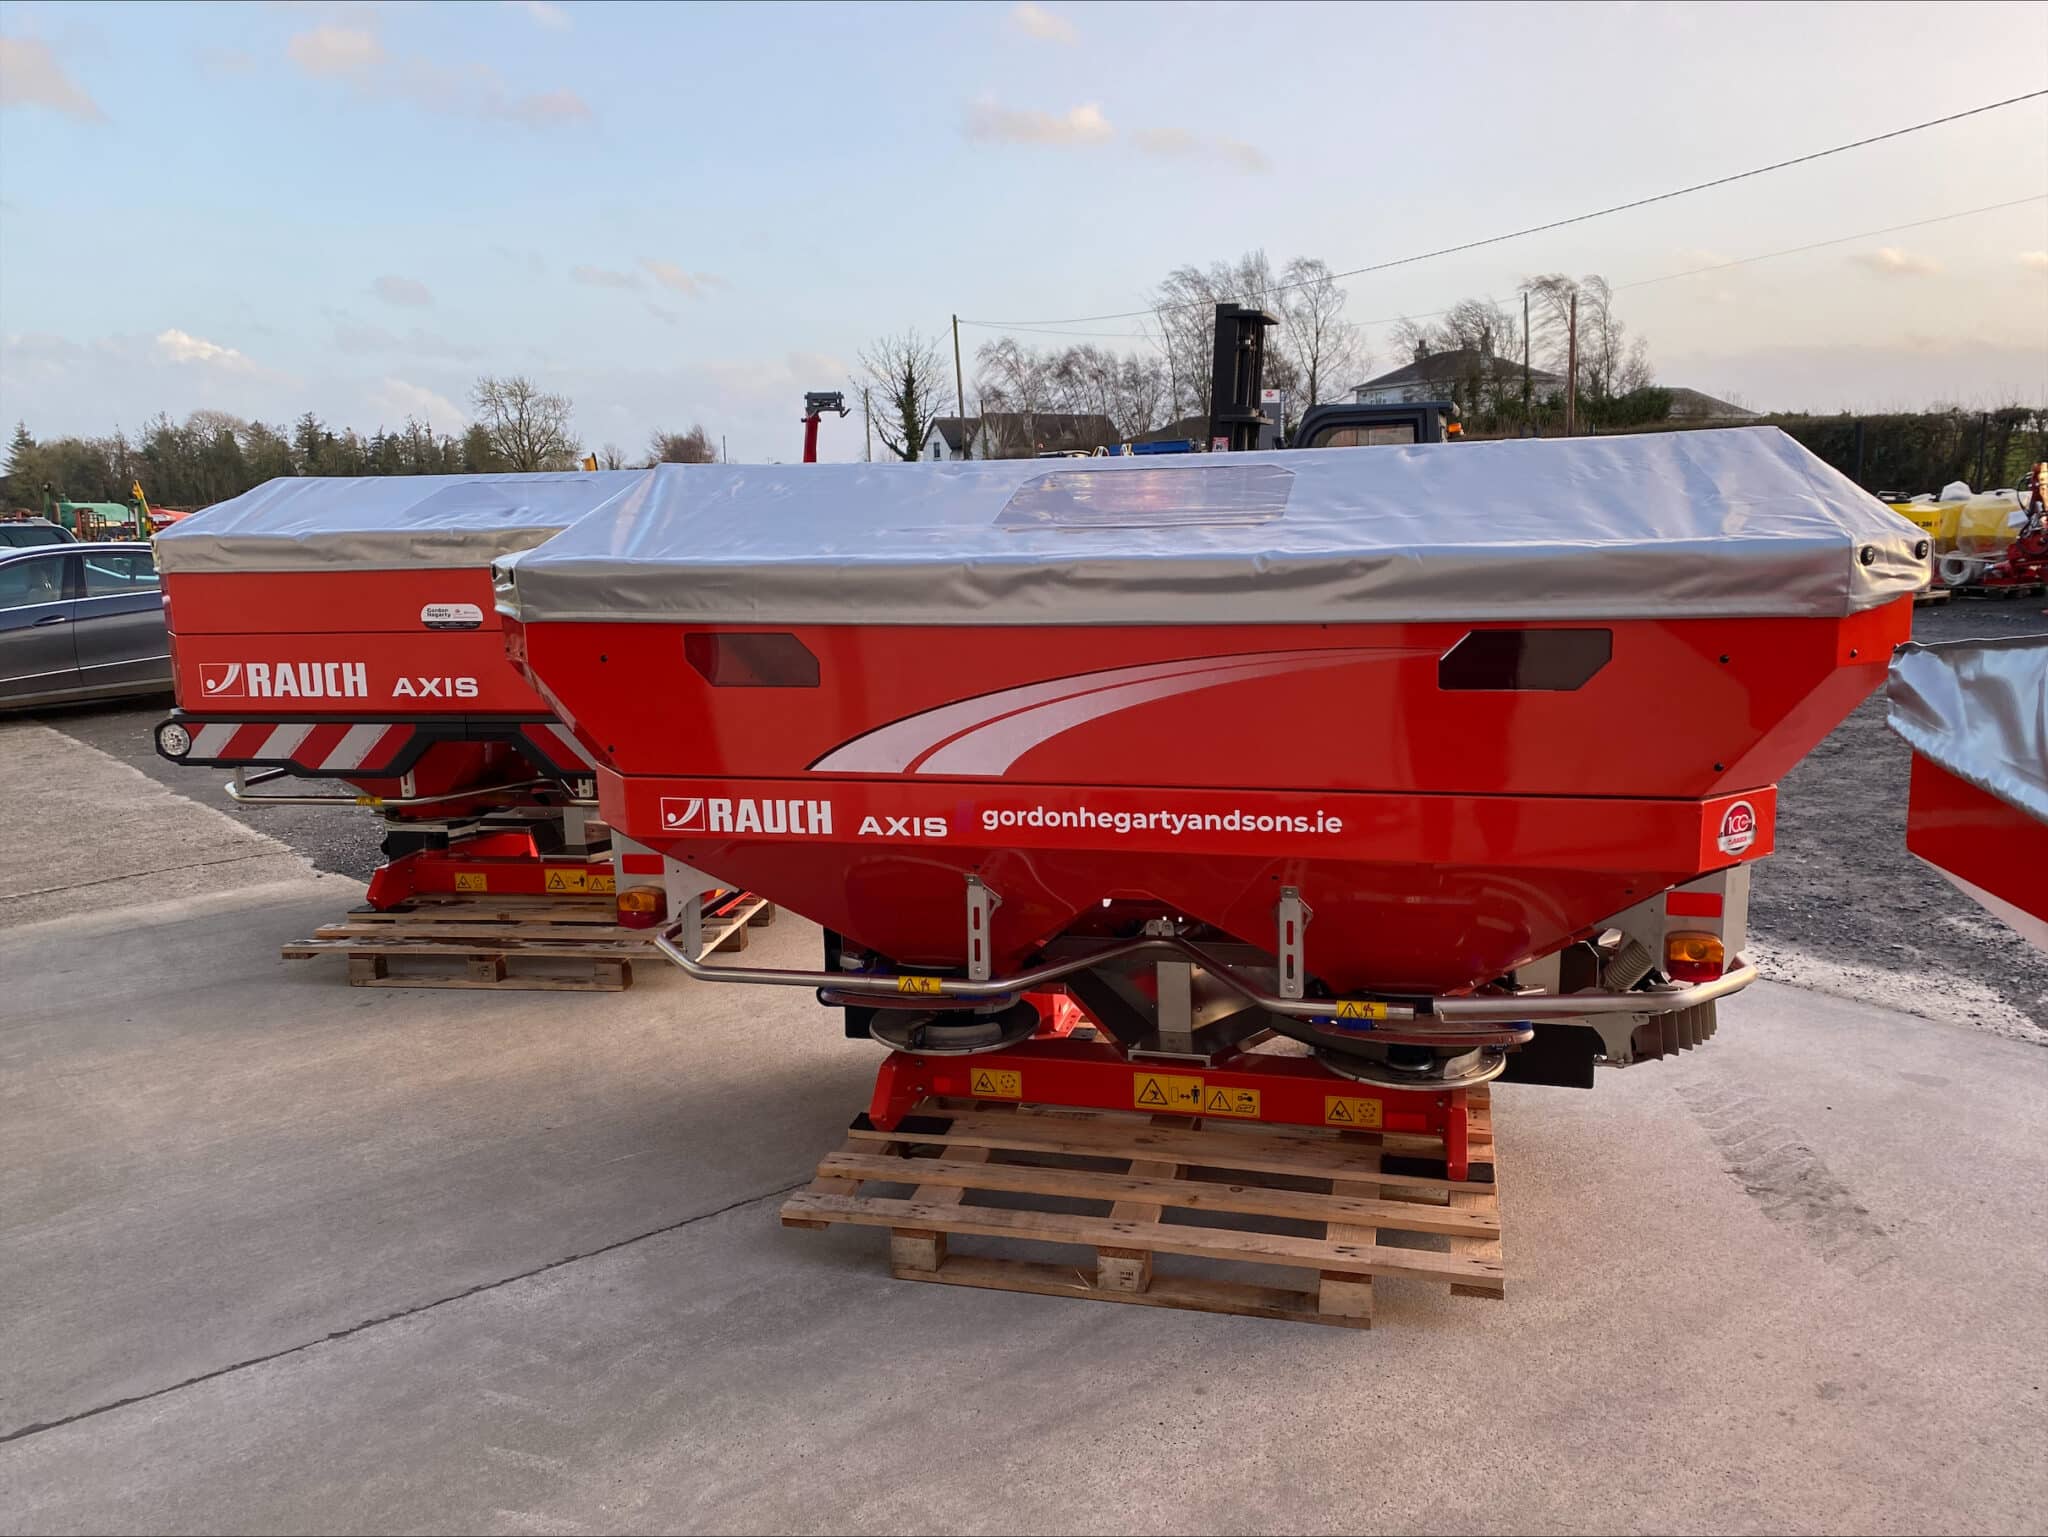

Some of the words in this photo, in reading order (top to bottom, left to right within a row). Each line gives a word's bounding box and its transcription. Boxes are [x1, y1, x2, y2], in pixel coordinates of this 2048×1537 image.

[246, 662, 368, 697] RAUCH
[392, 677, 479, 698] AXIS
[708, 798, 833, 834] RAUCH
[858, 815, 948, 837] AXIS
[982, 806, 1343, 834] gordonhegartyandsons.ie
